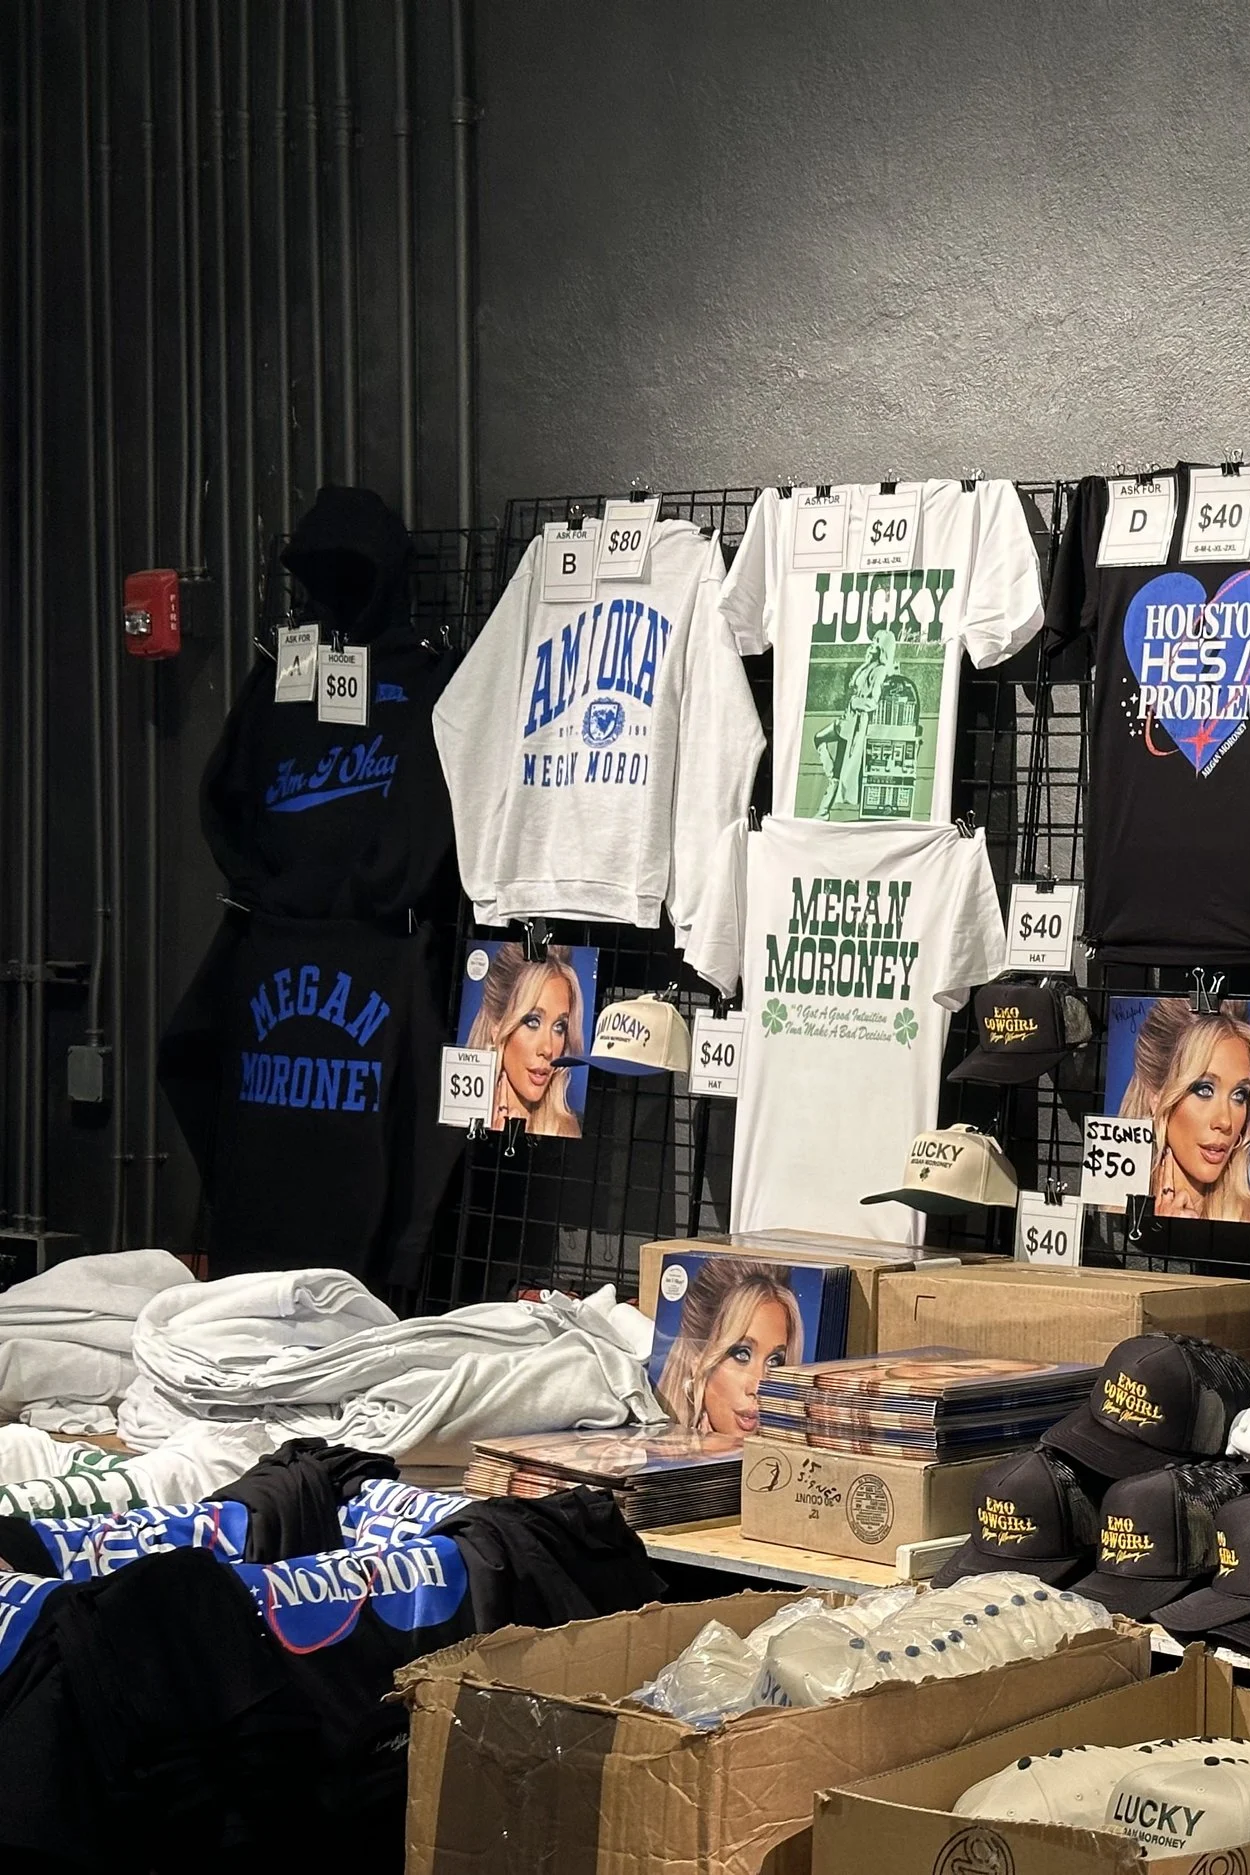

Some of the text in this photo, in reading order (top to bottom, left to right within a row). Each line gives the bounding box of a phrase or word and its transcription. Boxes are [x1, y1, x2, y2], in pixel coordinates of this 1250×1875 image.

[823, 495, 840, 505] FOR
[1120, 483, 1162, 496] ASK FOR
[1128, 509, 1148, 533] D
[1198, 502, 1243, 533] $40
[556, 531, 587, 540] ASK FOR
[812, 518, 827, 542] C
[870, 518, 908, 546] $40
[608, 529, 642, 556] $80
[562, 553, 577, 576] B
[810, 568, 956, 643] LUCKY
[285, 633, 311, 644] ASK FOR
[328, 654, 355, 664] HOODIE
[326, 673, 358, 699] $80
[523, 611, 587, 739] AM
[523, 750, 649, 788] MEGAN MORO
[788, 876, 912, 939] MEGAN
[1019, 912, 1062, 941] $40
[764, 933, 920, 1001] MORONEY
[1029, 954, 1046, 963] HAT
[250, 965, 391, 1048] MEGAN
[829, 1007, 852, 1026] Good
[852, 1008, 887, 1023] Intuition
[993, 1006, 1020, 1019] EMO
[611, 1012, 650, 1048] OKAY?
[804, 1022, 829, 1038] Make
[839, 1024, 857, 1040] Bad
[984, 1017, 1038, 1032] COWGIRL
[458, 1053, 480, 1063] VINYL
[701, 1040, 735, 1068] $40
[450, 1074, 484, 1098] $30
[708, 1080, 722, 1089] HAT
[1086, 1120, 1153, 1145] SIGNED
[911, 1140, 965, 1162] LUCKY
[1082, 1144, 1136, 1178] $50
[1025, 1226, 1067, 1256] $40
[1117, 1371, 1147, 1398] EMO
[1104, 1379, 1163, 1419] COWGIRL
[795, 1492, 823, 1506] COUNT
[986, 1496, 1015, 1515] EMO
[977, 1507, 1037, 1531] COWGIRL
[1107, 1515, 1134, 1533] EMO
[262, 1547, 447, 1610] HOUSTON
[1113, 1792, 1206, 1837] LUCKY
[1138, 1830, 1187, 1850] MORONEY
